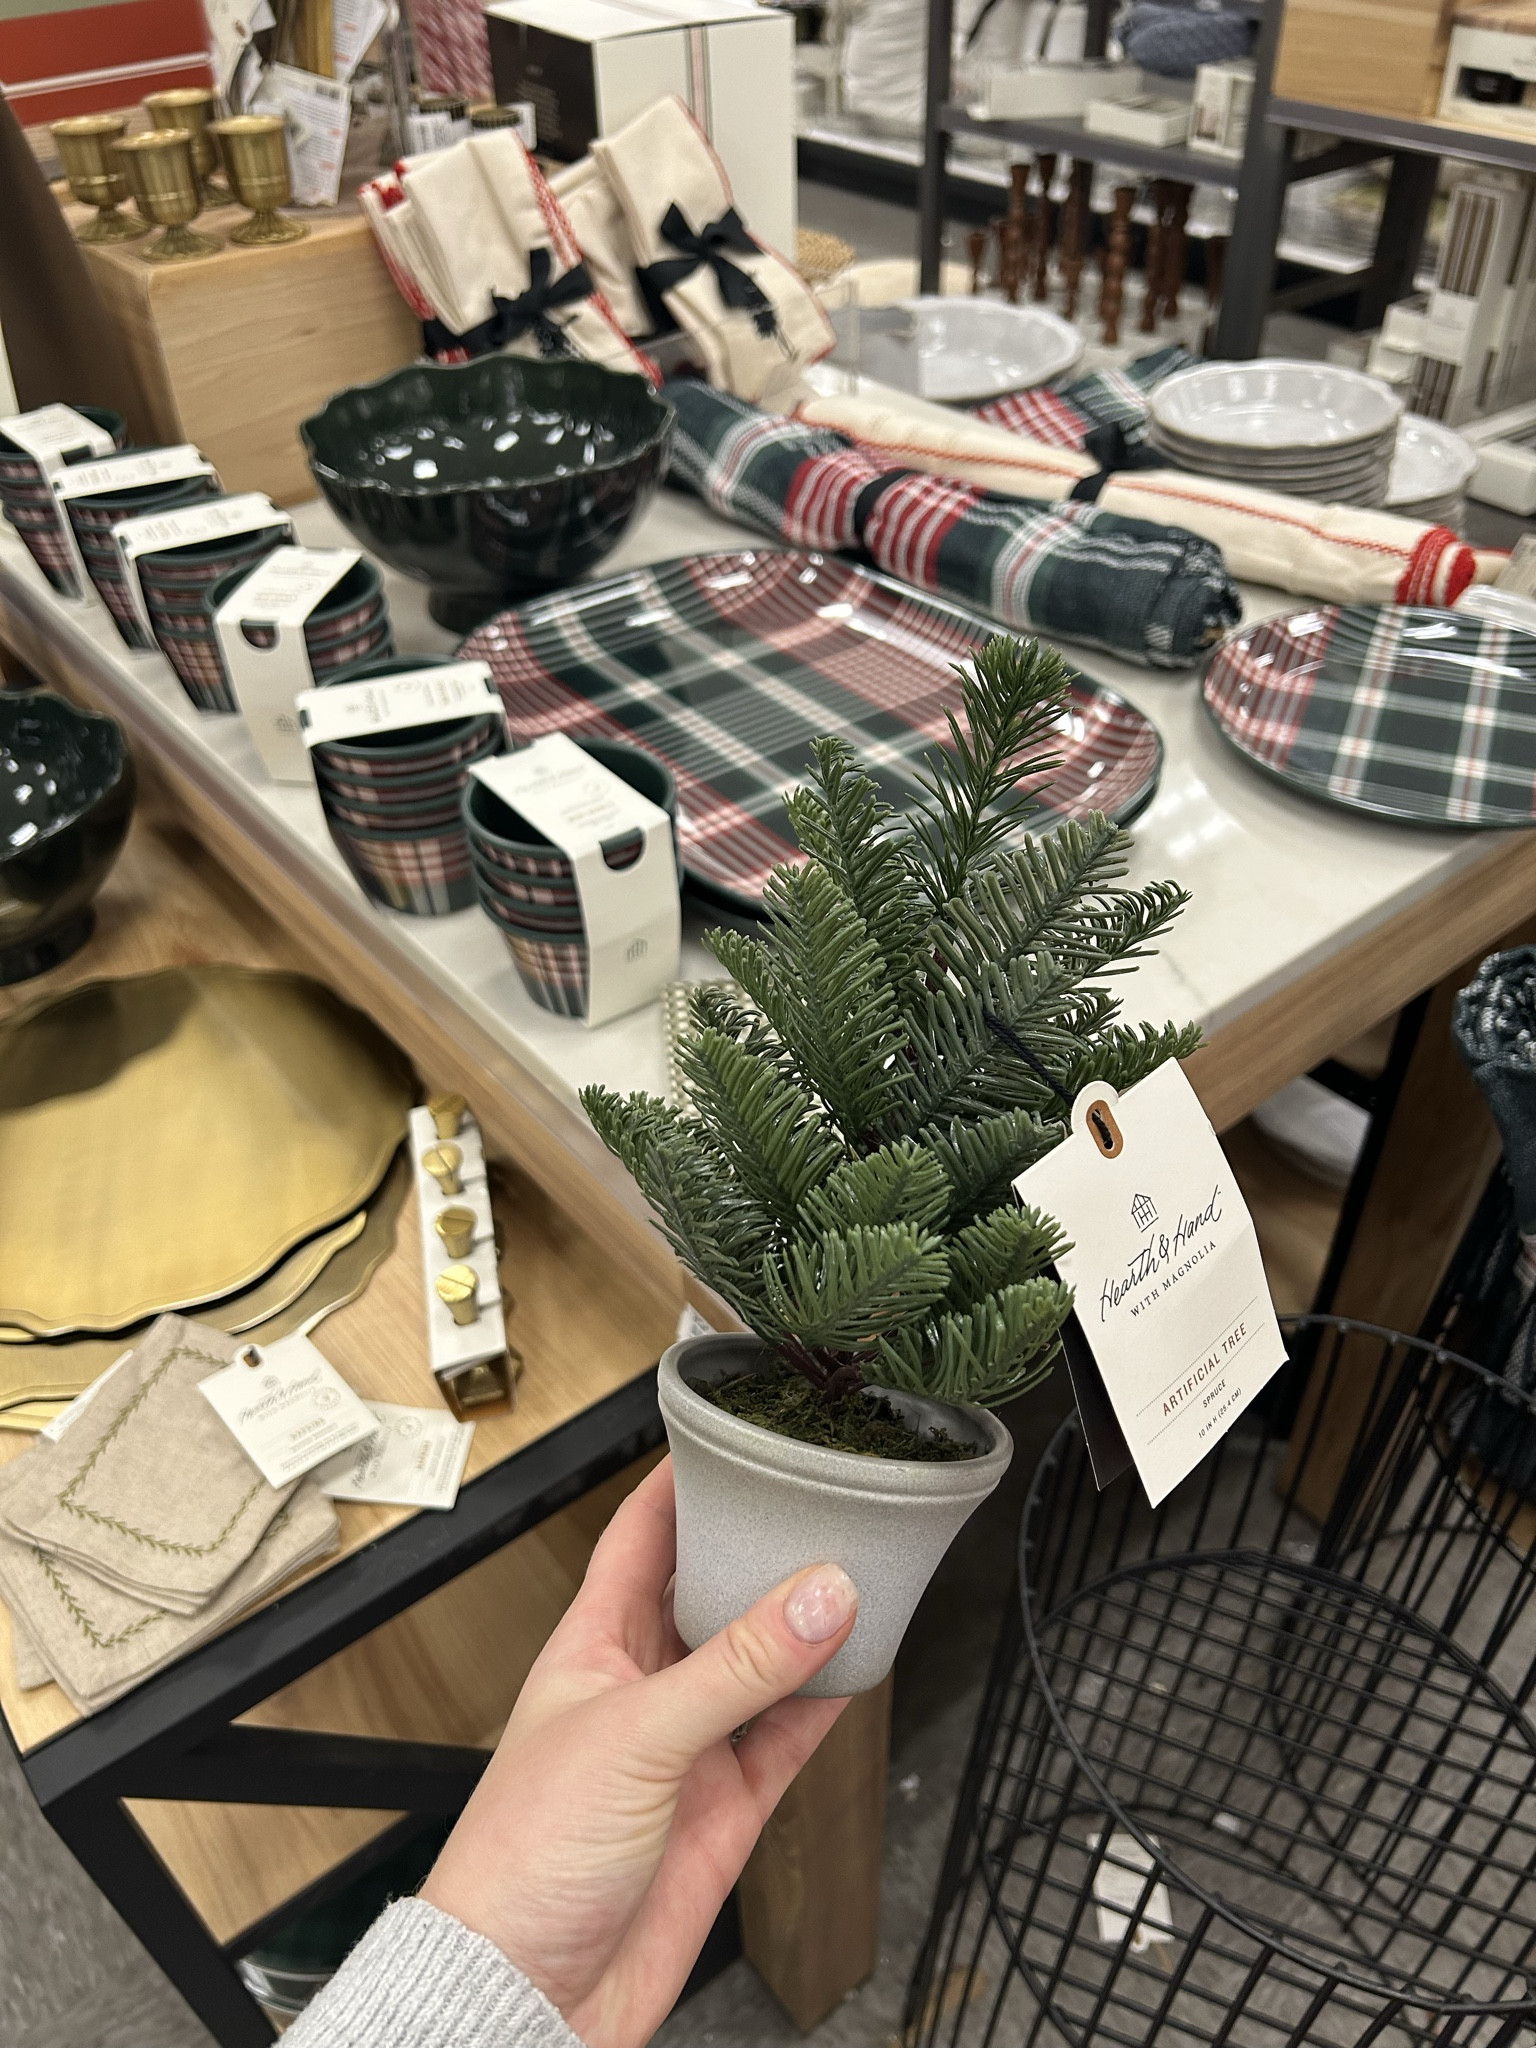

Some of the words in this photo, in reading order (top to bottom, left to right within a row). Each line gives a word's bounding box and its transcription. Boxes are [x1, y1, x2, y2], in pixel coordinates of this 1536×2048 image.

[1099, 1233, 1160, 1322] Hearth
[1158, 1233, 1170, 1264] &
[1173, 1184, 1222, 1256] Hand
[1130, 1289, 1160, 1317] WITH
[1162, 1240, 1216, 1291] MAGNOLIA
[1162, 1352, 1221, 1417] ARTIFICIAL
[1221, 1322, 1247, 1354] TREE
[1202, 1379, 1227, 1408] SPRUCE
[1198, 1428, 1206, 1439] 10
[1206, 1422, 1213, 1432] IN
[1212, 1416, 1218, 1424] H
[1231, 1386, 1242, 1402] CM)
